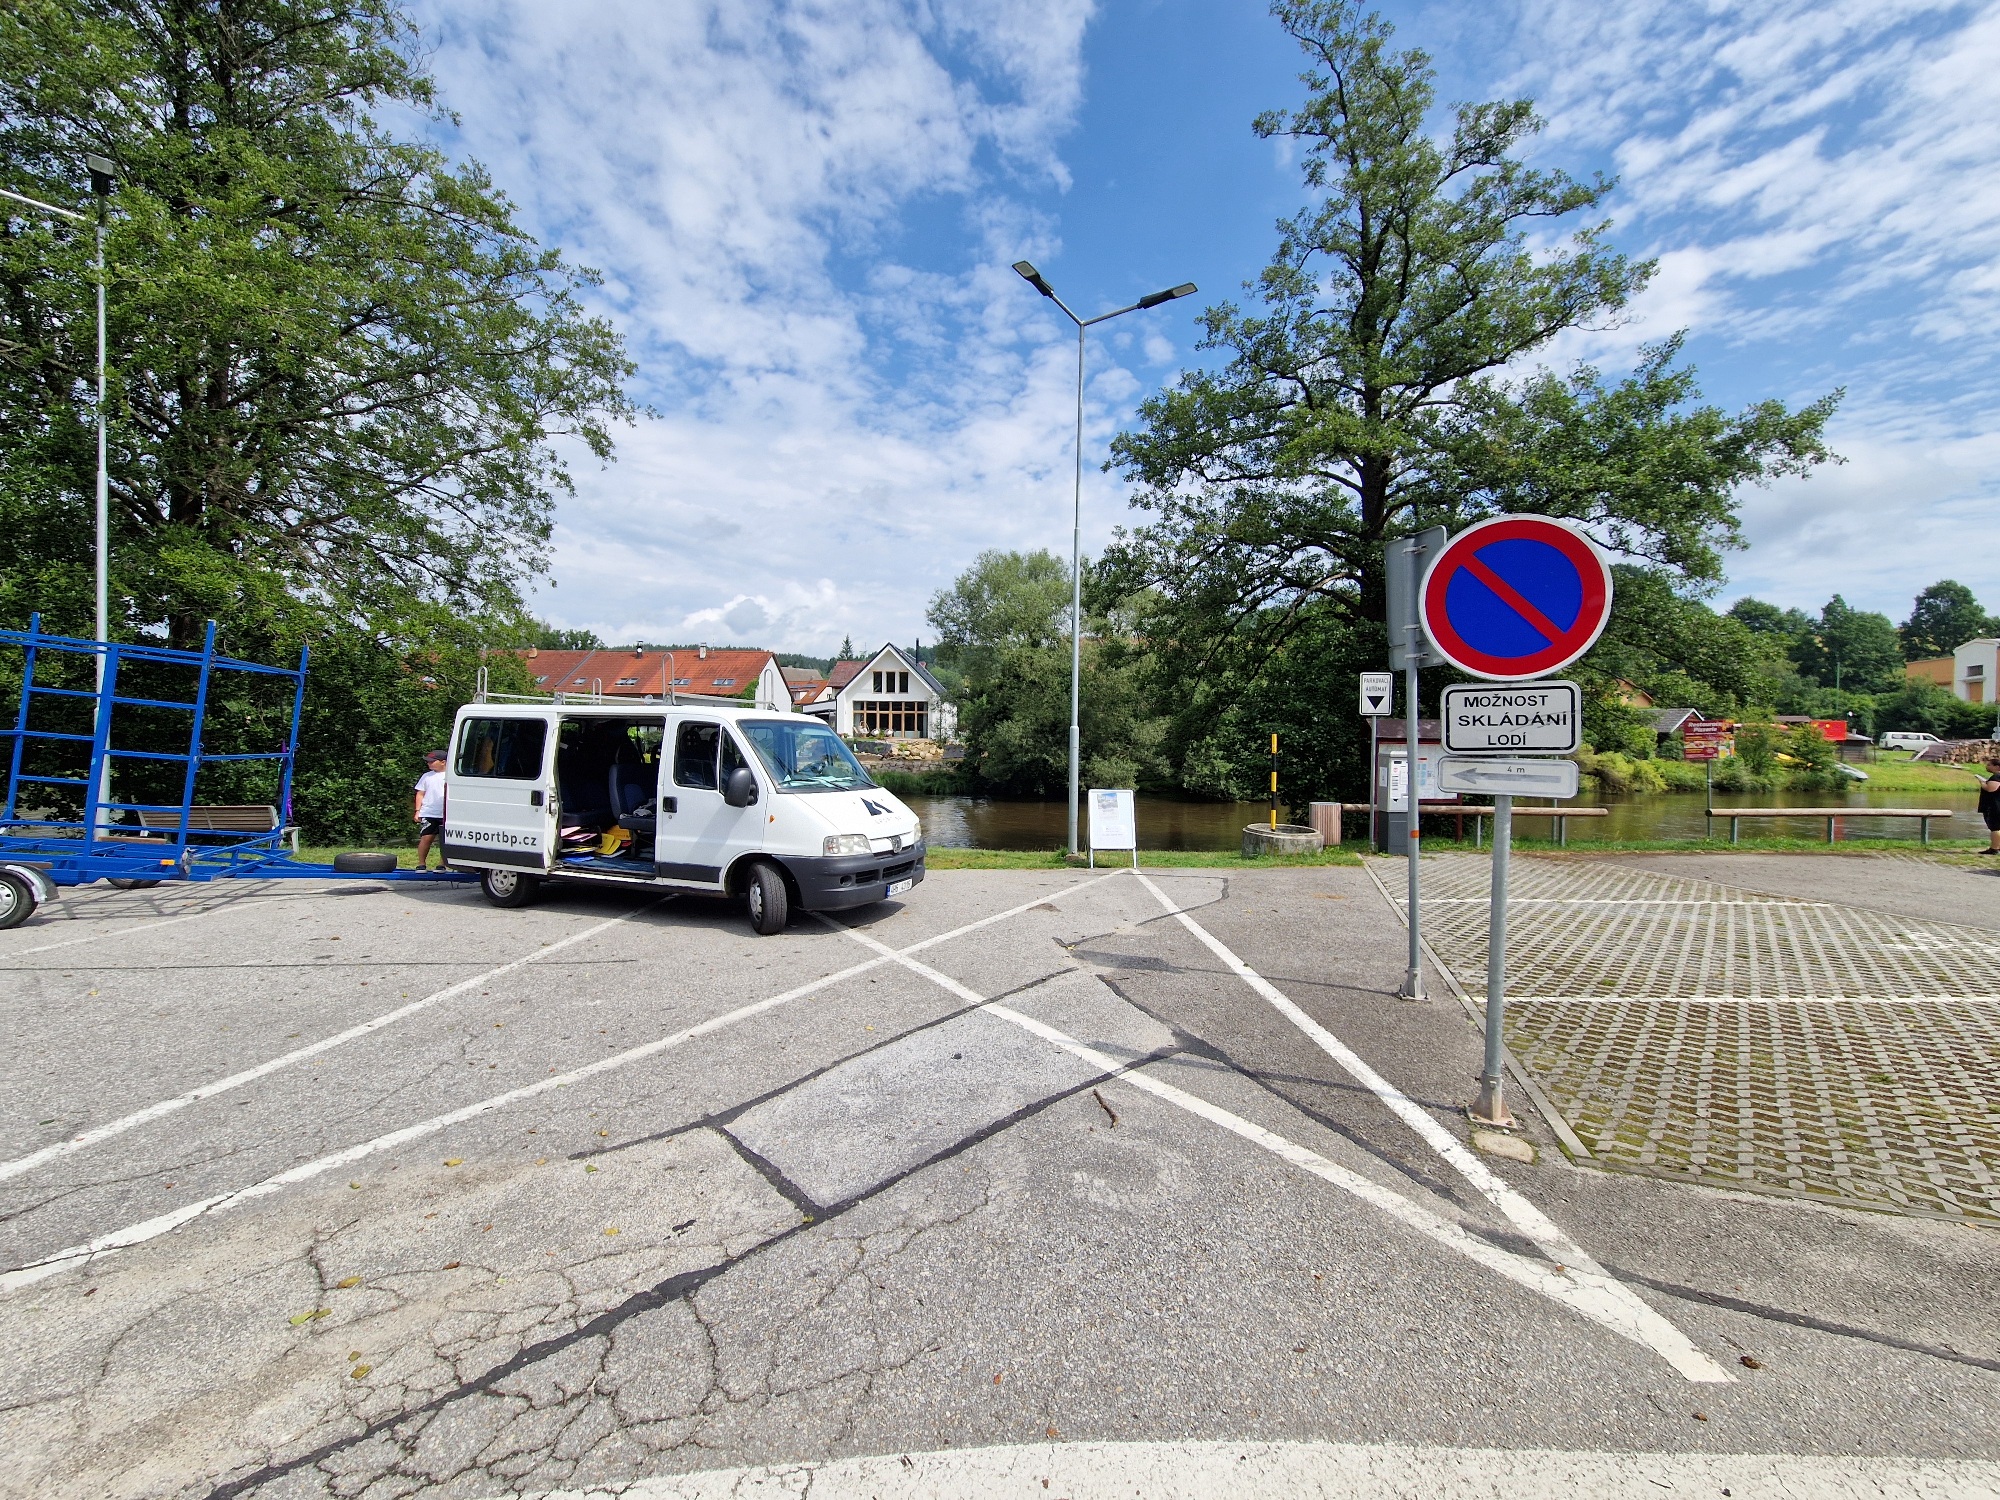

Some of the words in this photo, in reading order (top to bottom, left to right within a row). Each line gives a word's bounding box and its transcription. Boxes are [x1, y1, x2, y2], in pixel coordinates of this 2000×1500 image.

[1464, 693, 1548, 708] MOŽNOST
[1458, 711, 1567, 727] SKLÁDÁNÍ
[1488, 732, 1526, 746] LODÍ
